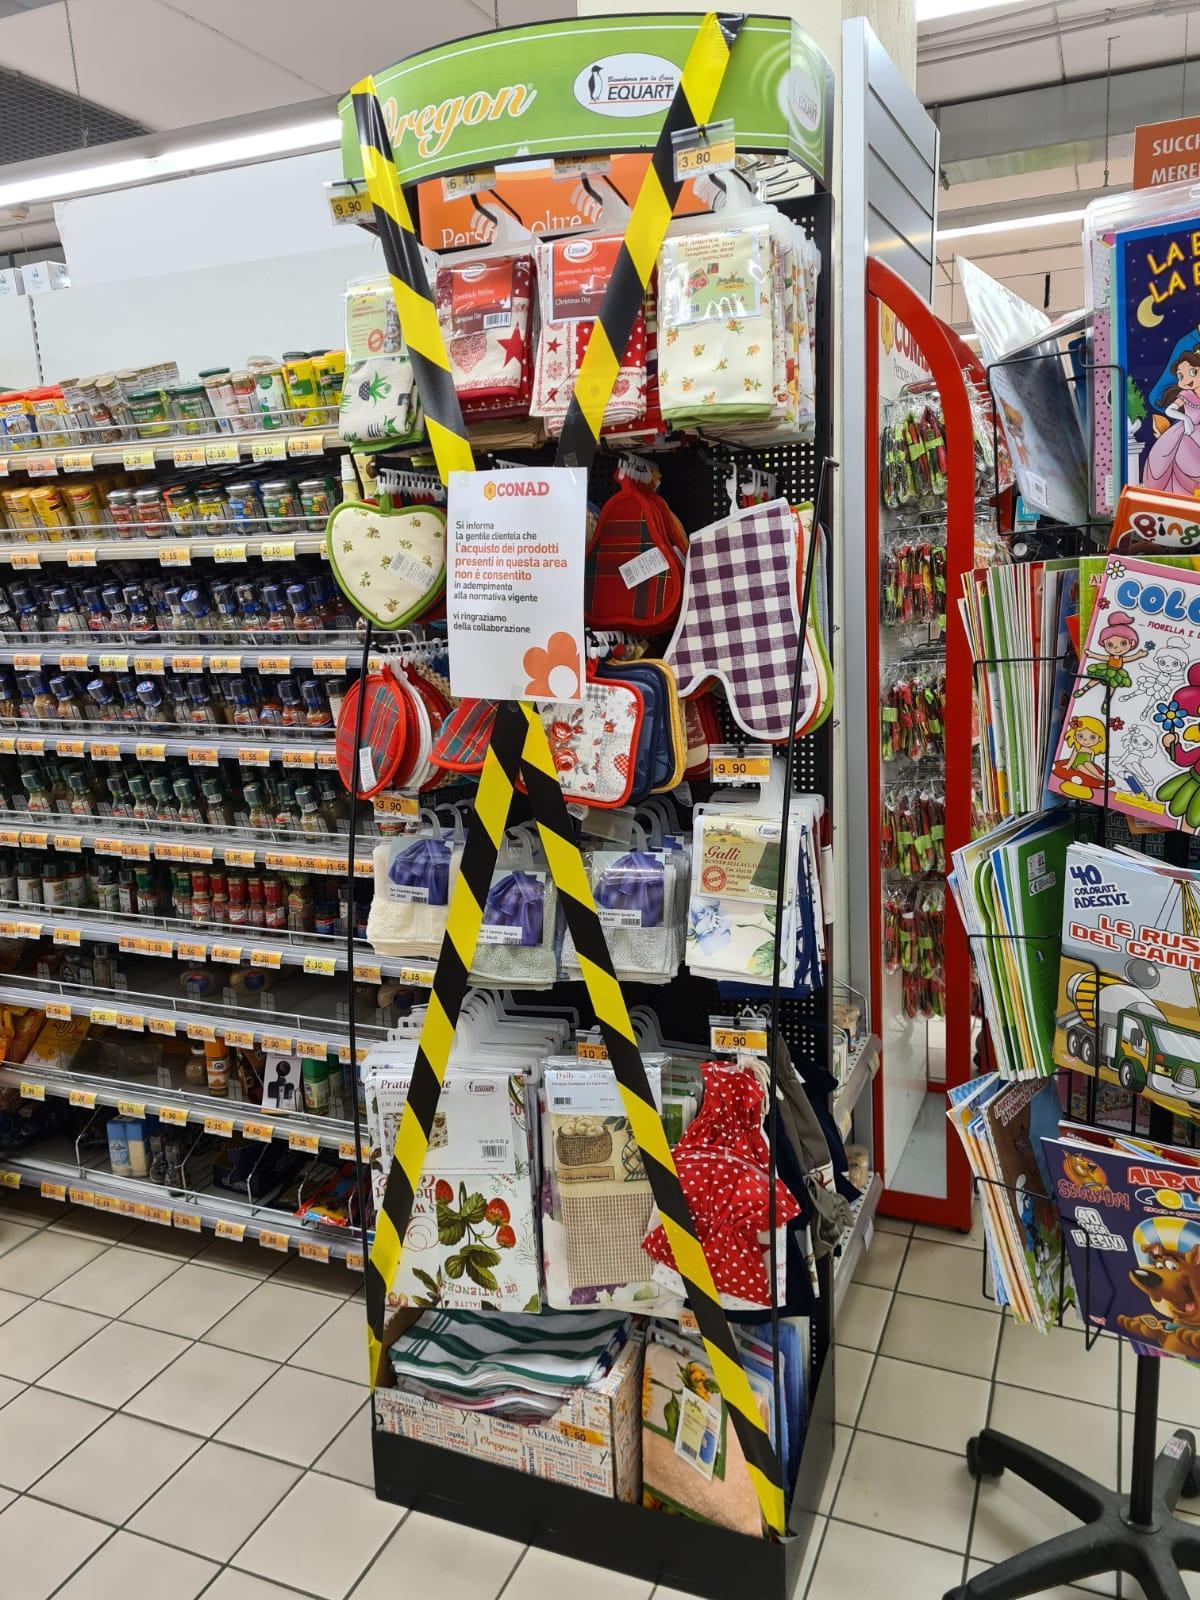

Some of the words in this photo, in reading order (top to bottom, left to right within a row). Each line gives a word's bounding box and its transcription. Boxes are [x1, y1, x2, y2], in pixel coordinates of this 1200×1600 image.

[607, 85, 674, 100] EQUART
[1147, 241, 1185, 275] LA
[1148, 270, 1187, 303] LA
[555, 296, 580, 305] Christmas
[580, 296, 592, 305] Day
[496, 481, 550, 497] CONAD
[456, 520, 465, 530] Si
[466, 521, 495, 530] informa
[455, 532, 464, 540] la
[465, 532, 490, 542] gentile
[491, 532, 521, 540] clientela
[522, 532, 537, 540] che
[455, 543, 500, 556] l'acquisto
[502, 543, 515, 554] dei
[517, 543, 559, 556] prodotti
[455, 556, 494, 570] presenti
[496, 556, 504, 567] in
[506, 557, 540, 570] questa
[543, 558, 568, 568] area
[454, 571, 473, 580] non
[482, 569, 532, 581] consentito
[454, 581, 461, 589] in
[462, 582, 513, 593] adempimento
[453, 591, 468, 600] alla
[469, 592, 506, 601] normativa
[507, 593, 538, 604] vigente
[453, 612, 460, 620] vi
[460, 613, 507, 623] ringraziamo
[453, 622, 472, 631] della
[472, 623, 531, 633] collaborazione
[1147, 620, 1185, 635] FIORELLA
[315, 661, 332, 669] 1.55
[704, 845, 741, 861] Galli
[1070, 864, 1103, 886] 40
[1074, 885, 1117, 896] COLORATI
[1074, 893, 1131, 909] ADESIVI
[1099, 914, 1134, 939] LE
[1070, 922, 1121, 951] DEL
[305, 960, 322, 968] 2.10
[1076, 1206, 1101, 1225] 40
[480, 1435, 518, 1454] Oregon
